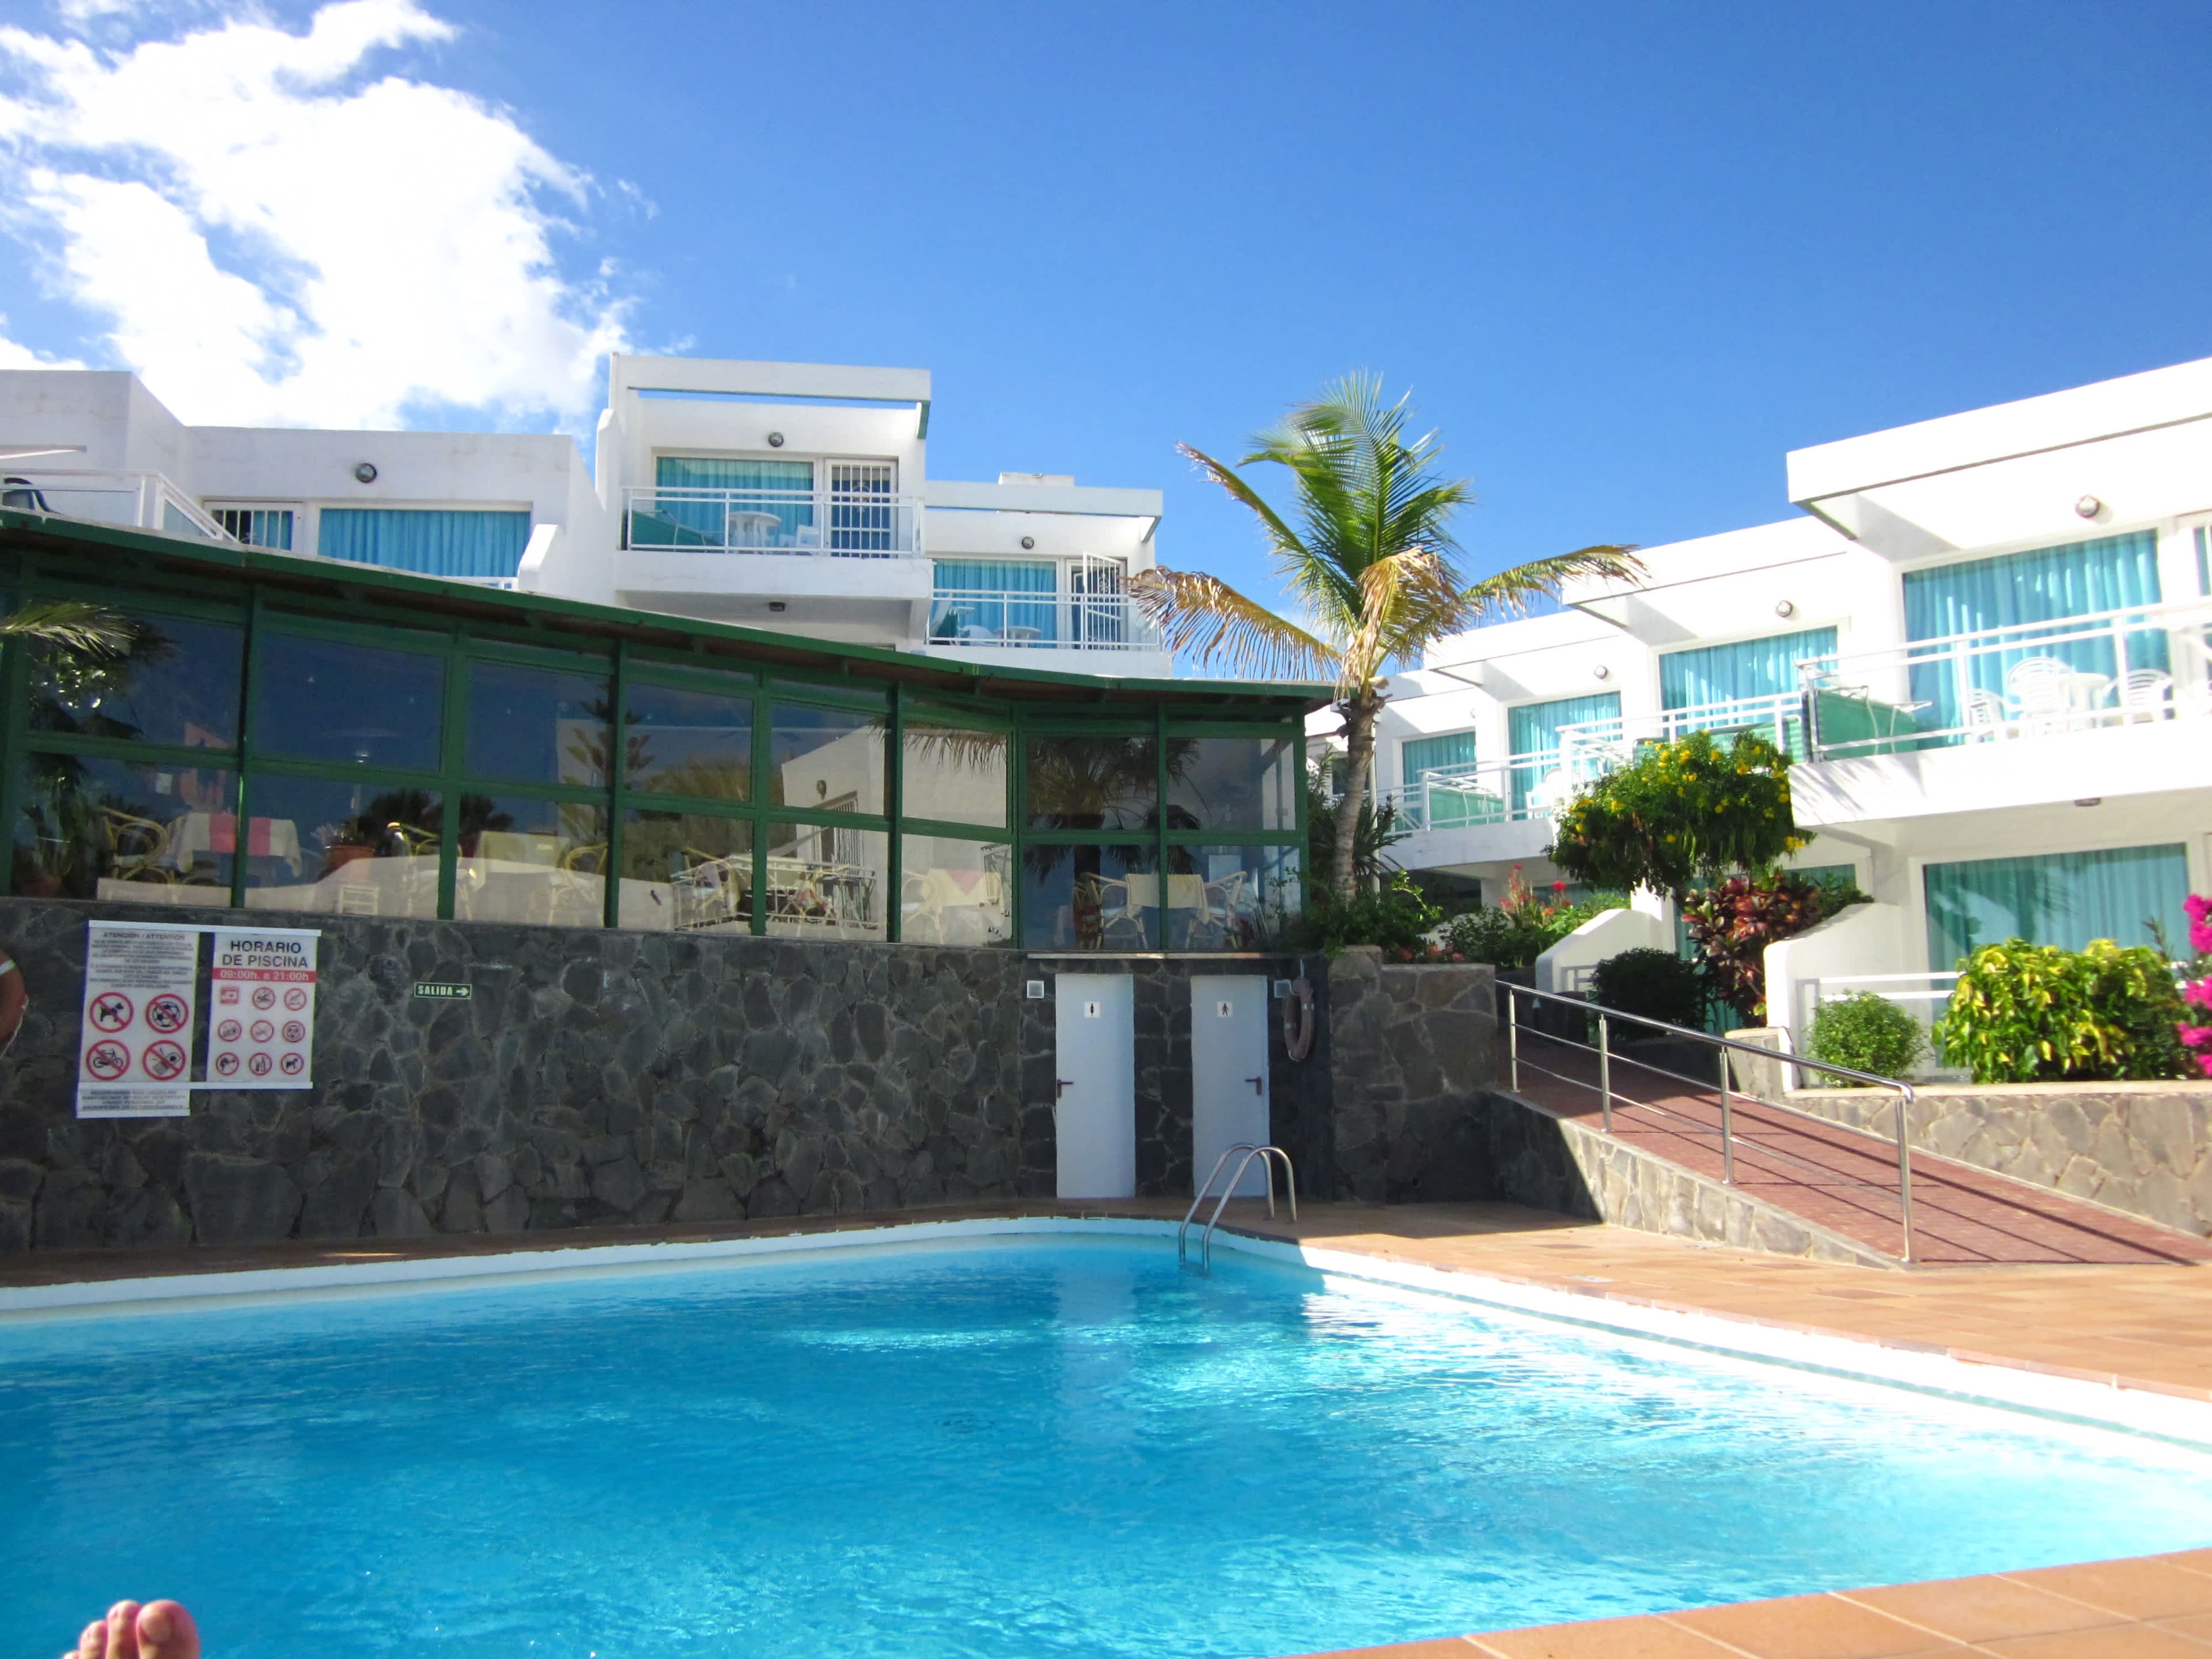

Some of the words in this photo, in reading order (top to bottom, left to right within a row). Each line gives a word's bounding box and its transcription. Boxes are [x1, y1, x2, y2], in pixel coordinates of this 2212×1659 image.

[230, 940, 301, 953] HORARIO
[222, 954, 243, 965] DE
[248, 955, 308, 968] PISCINA
[418, 986, 453, 995] SALIDA
